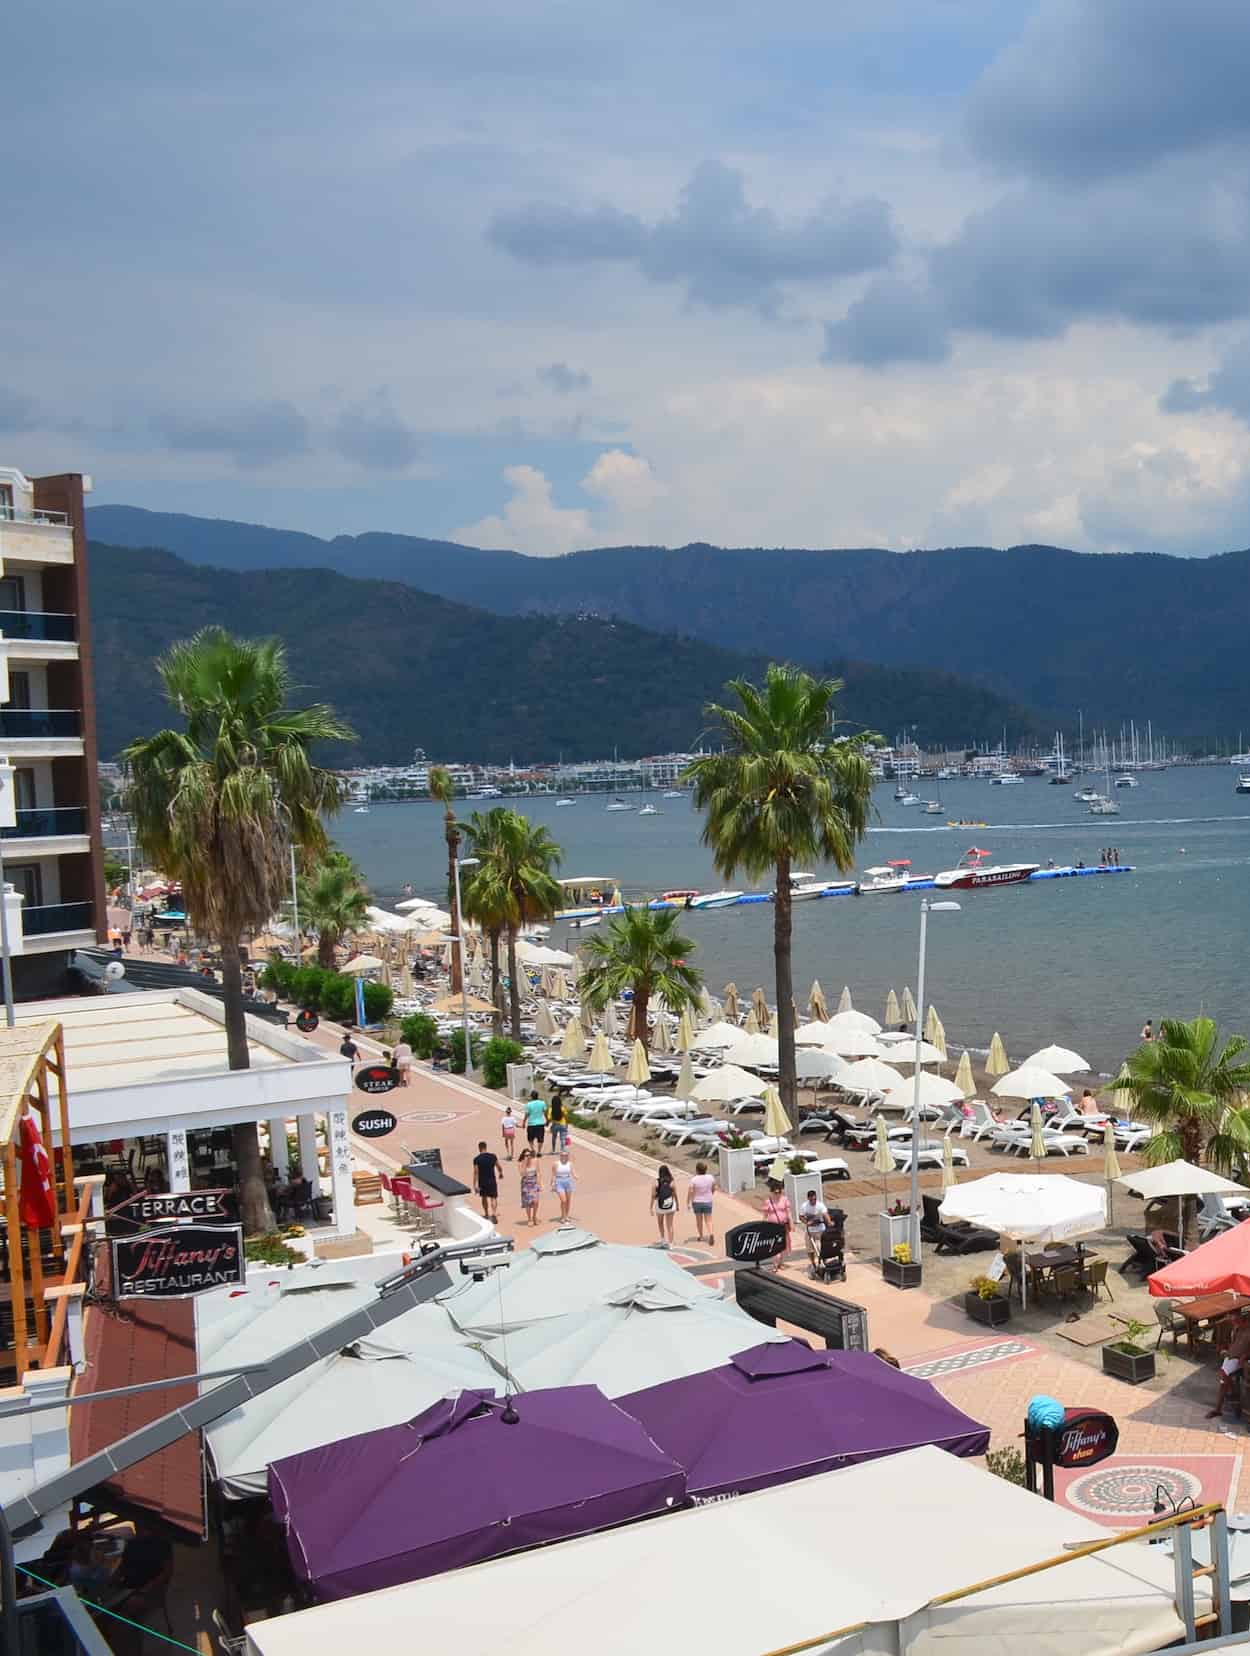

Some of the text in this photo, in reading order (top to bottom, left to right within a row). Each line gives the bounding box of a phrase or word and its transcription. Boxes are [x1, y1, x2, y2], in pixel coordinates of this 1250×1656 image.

[363, 1080, 393, 1088] STEAK
[358, 1118, 393, 1131] SUSHI
[129, 1196, 216, 1218] TERRACE
[734, 1231, 783, 1256] Tiffany's
[121, 1237, 236, 1280] Tiffany's
[121, 1270, 238, 1294] RESTAURANT
[1060, 1430, 1106, 1455] Tiffany's
